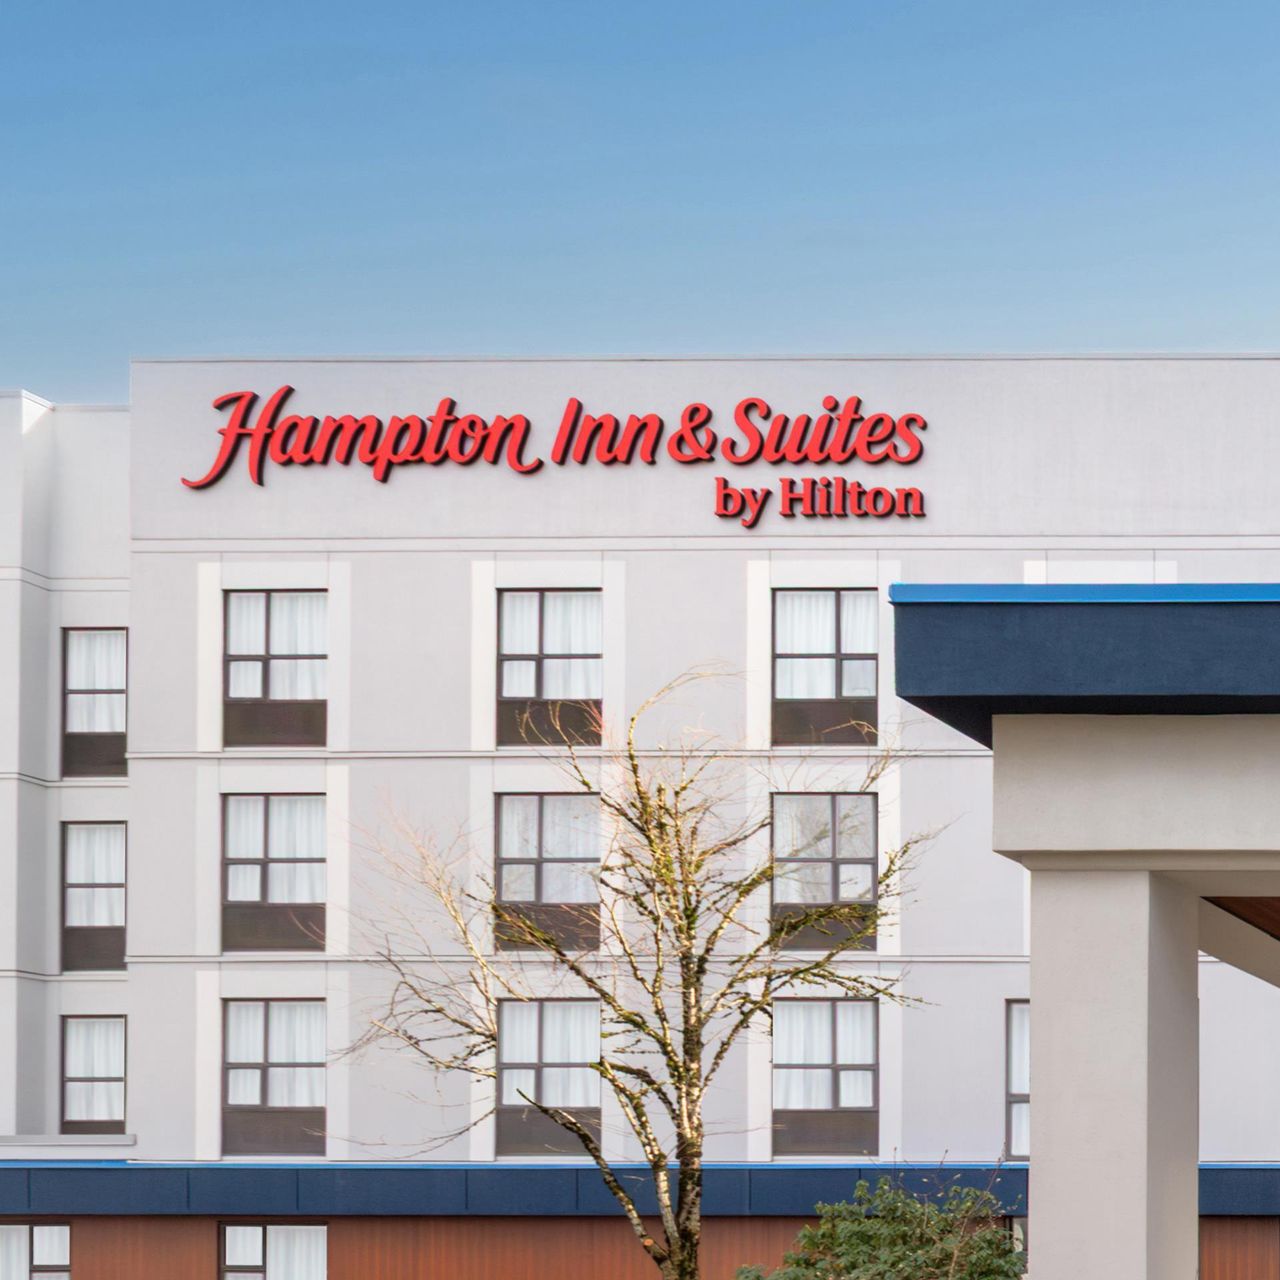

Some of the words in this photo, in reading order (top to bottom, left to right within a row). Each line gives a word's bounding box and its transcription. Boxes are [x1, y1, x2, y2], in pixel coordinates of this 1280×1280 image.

[182, 384, 545, 490] Hampton
[550, 397, 665, 466] Inn
[719, 395, 928, 466] Suites
[714, 475, 773, 529] by
[779, 475, 927, 520] Hilton
